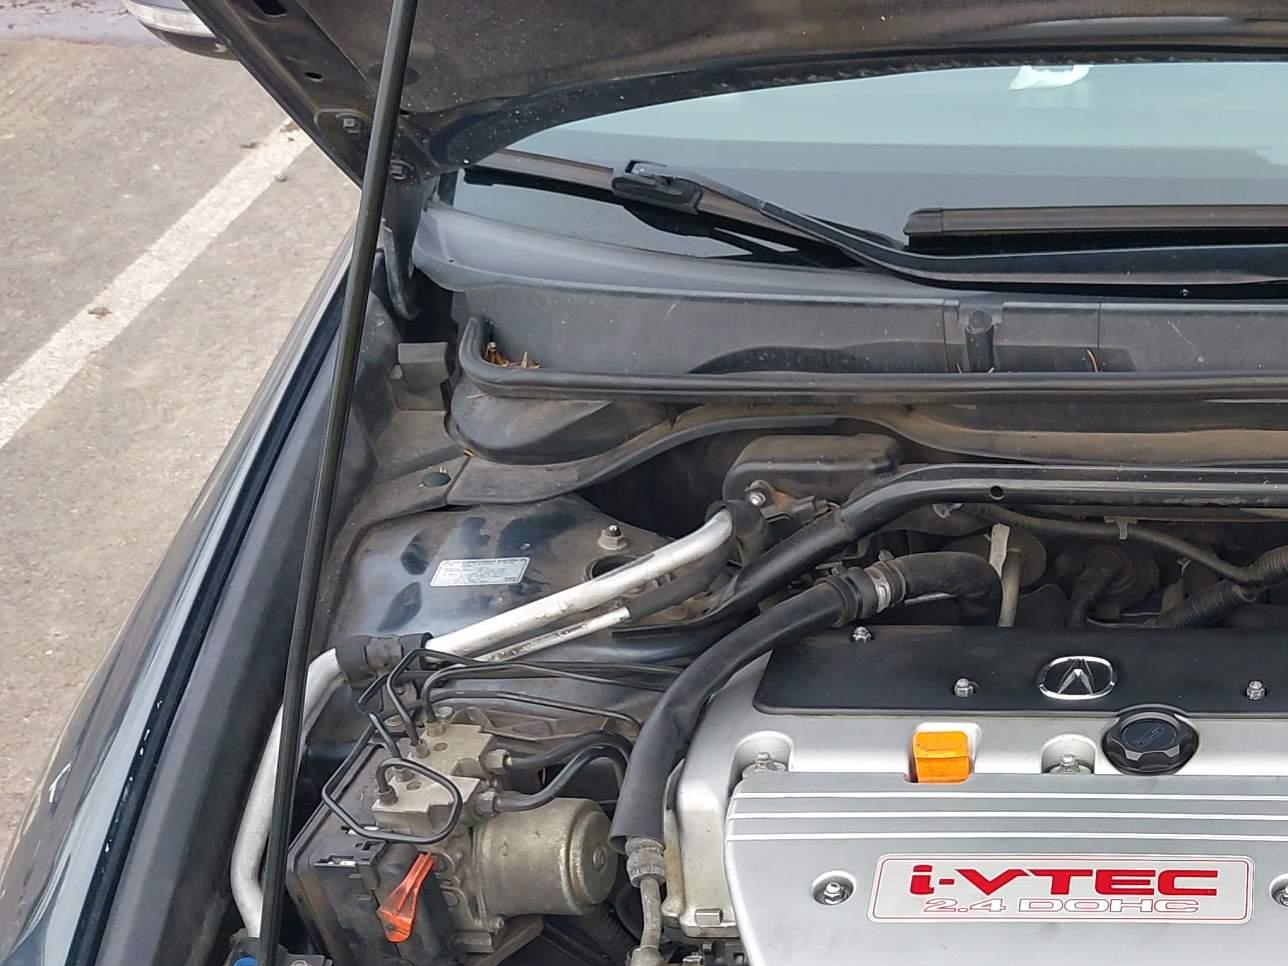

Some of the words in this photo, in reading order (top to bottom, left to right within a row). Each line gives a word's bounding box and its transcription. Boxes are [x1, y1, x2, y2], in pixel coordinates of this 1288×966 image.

[910, 864, 1218, 896] i-VTEC
[924, 898, 1007, 913] 2.4
[1018, 898, 1200, 913] DOHC
